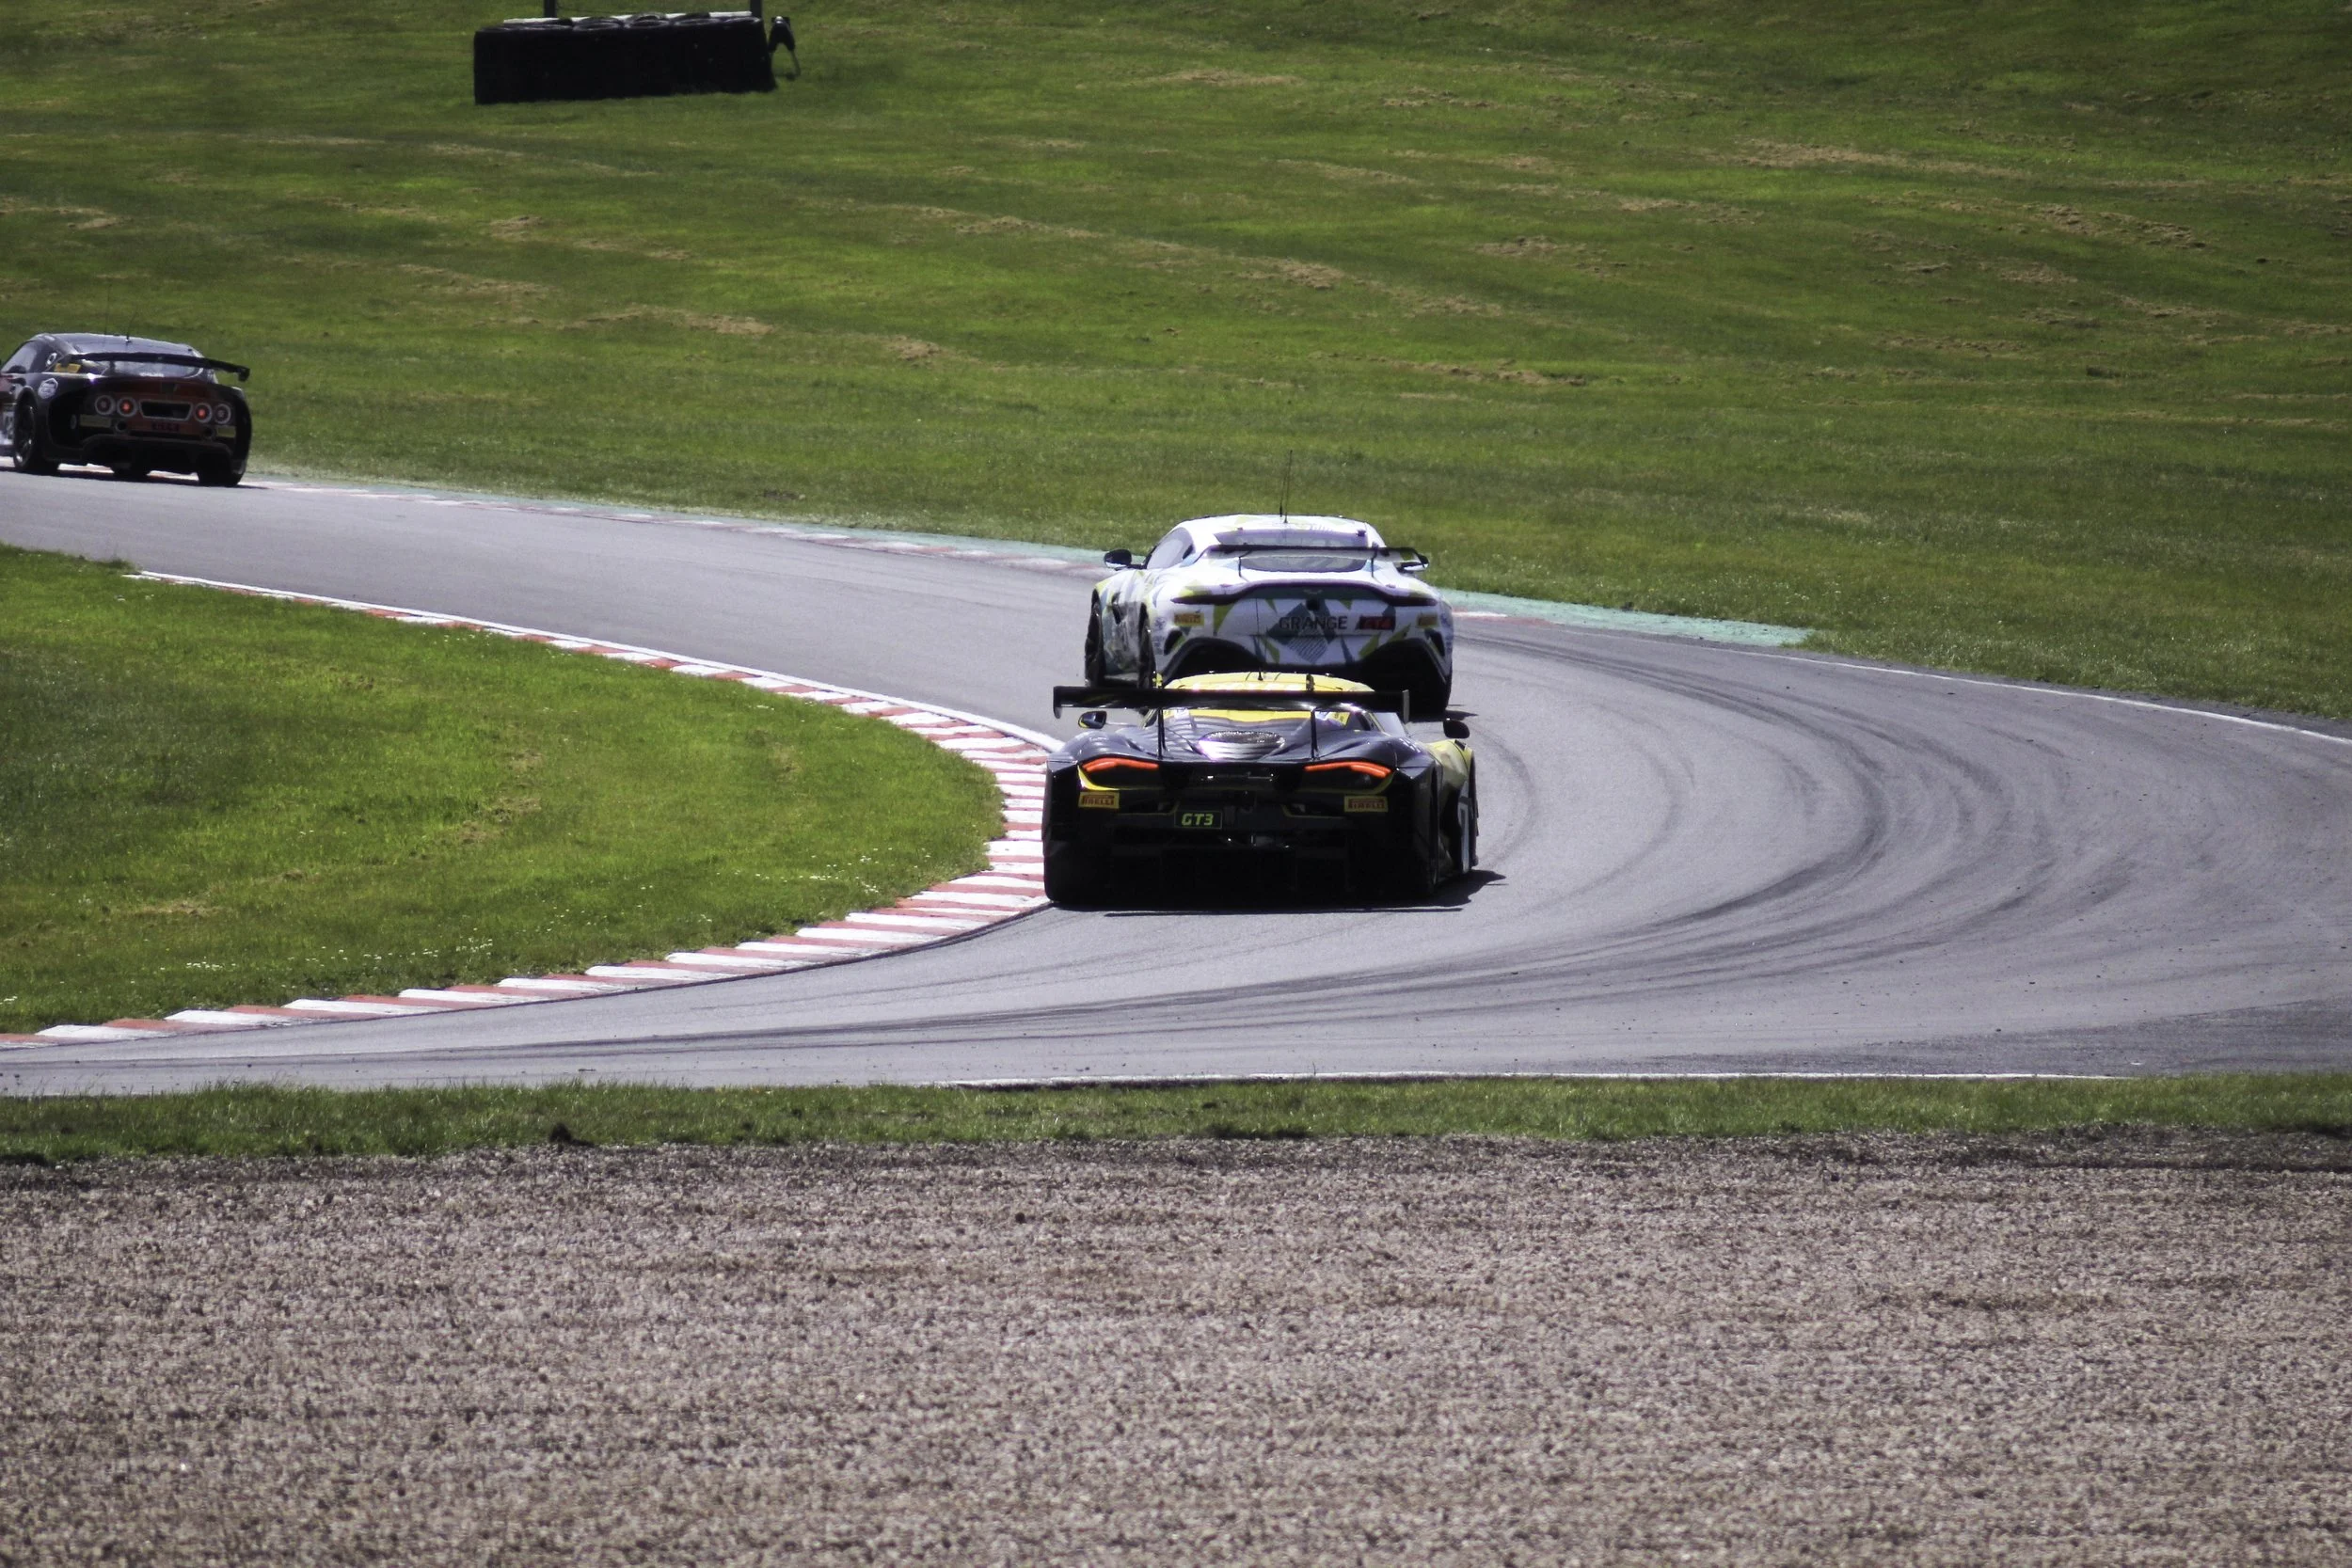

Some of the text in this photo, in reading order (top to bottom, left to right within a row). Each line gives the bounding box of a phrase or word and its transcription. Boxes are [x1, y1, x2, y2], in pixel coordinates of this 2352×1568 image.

[1279, 616, 1348, 629] GRANGE
[1082, 795, 1114, 806] PIRELLI
[1181, 813, 1214, 826] GT3
